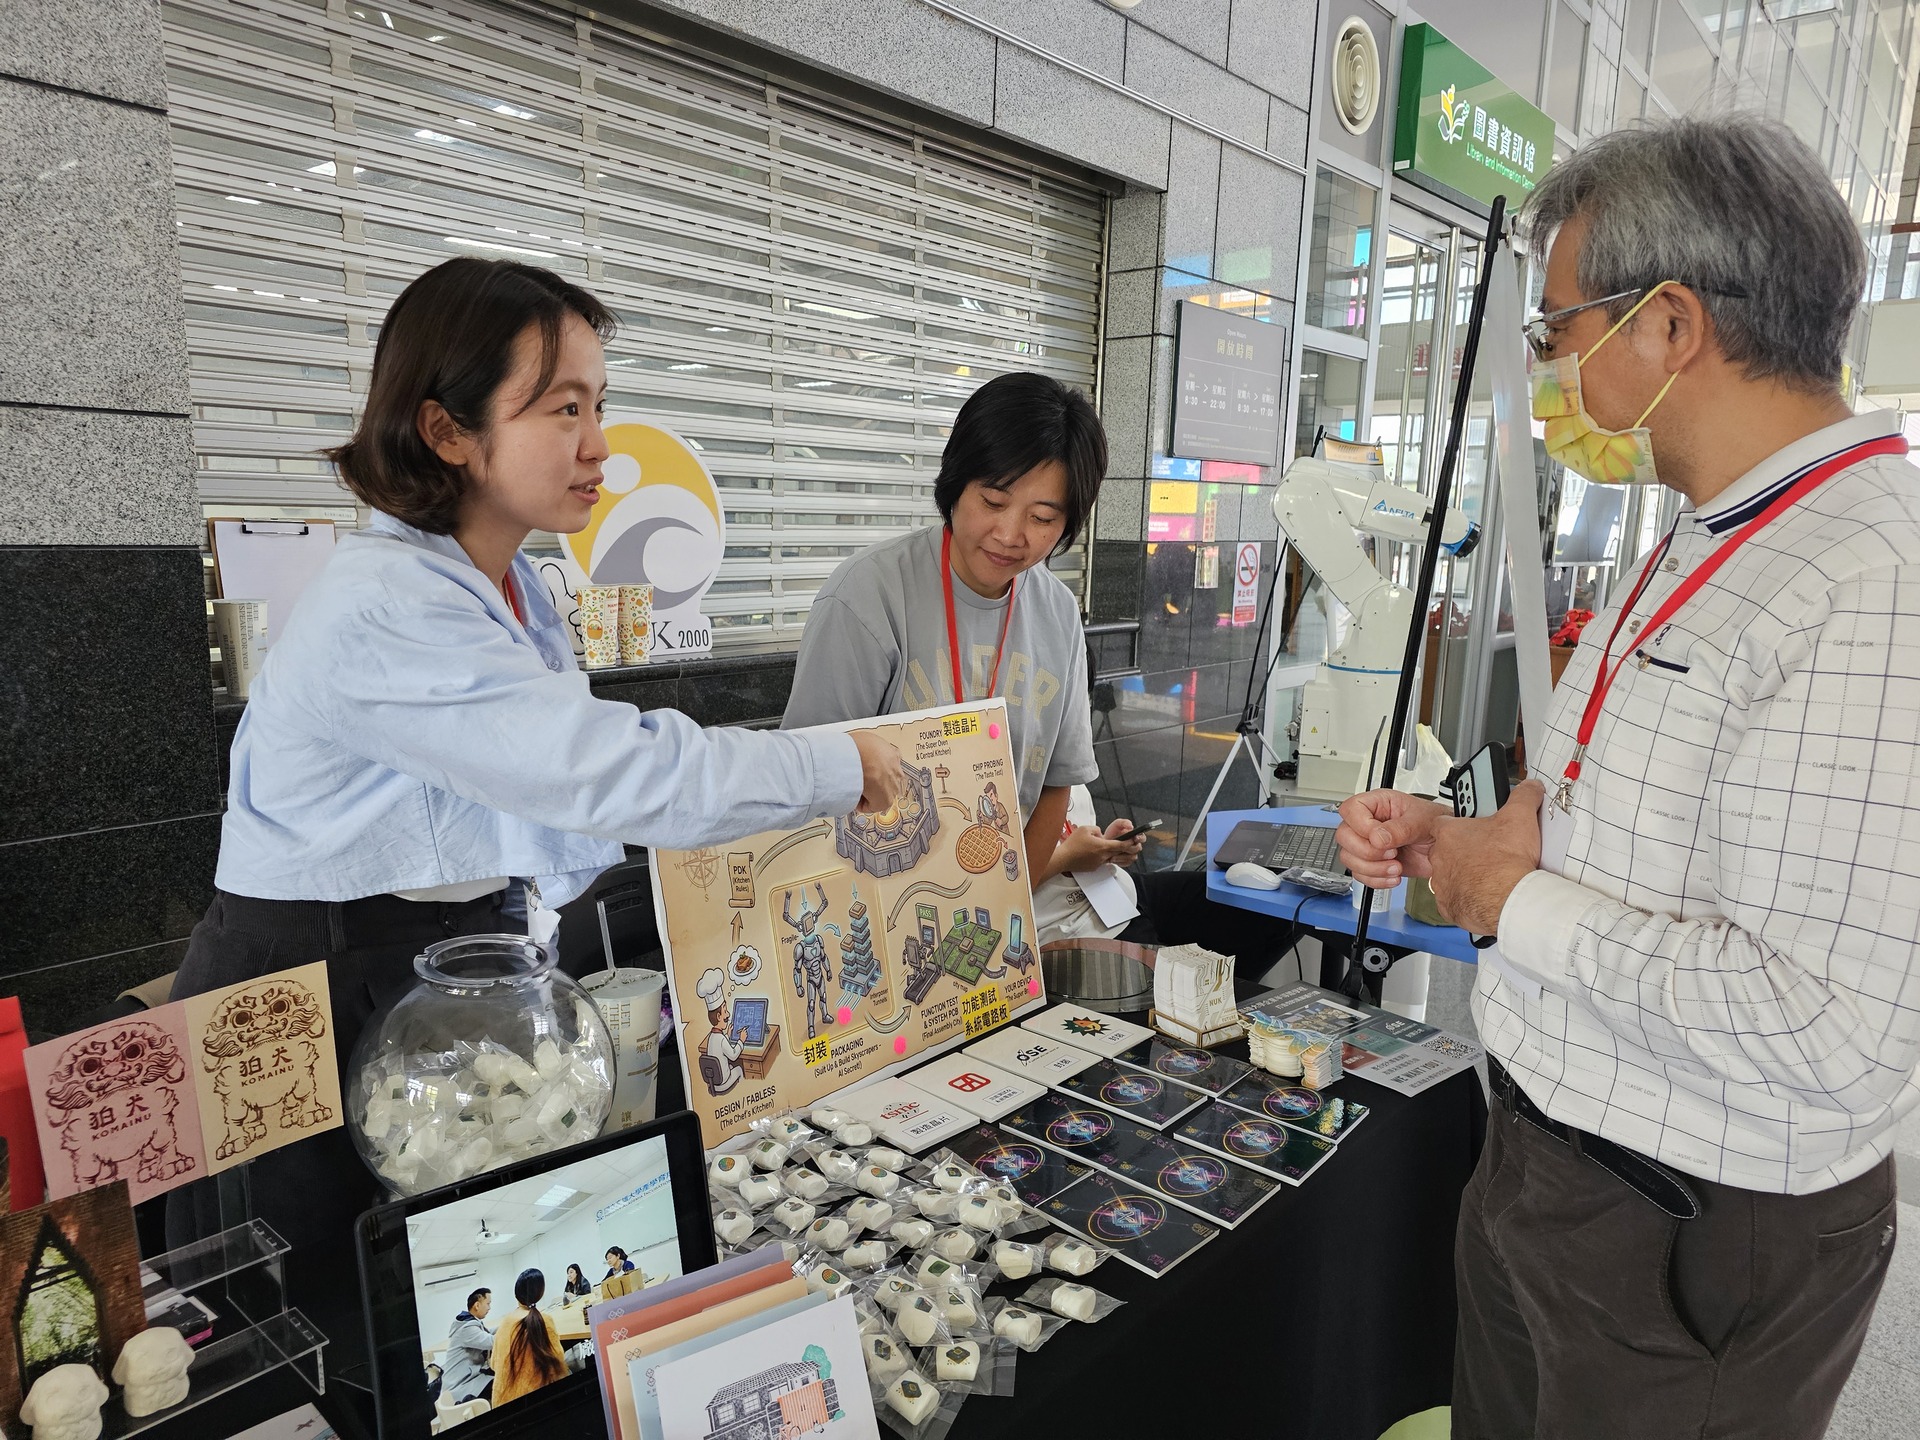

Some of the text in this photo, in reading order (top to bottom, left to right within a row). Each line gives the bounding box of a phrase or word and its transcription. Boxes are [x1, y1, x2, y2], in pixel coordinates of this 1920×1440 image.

[1473, 106, 1536, 173] 圖書資訊館
[1217, 338, 1253, 360] 開放時間
[1185, 395, 1198, 405] 8:30
[1210, 400, 1226, 410] 22:00
[1238, 404, 1249, 413] 8:30
[1261, 407, 1274, 417] 17:00
[678, 629, 709, 648] 2000
[1833, 639, 1874, 648] CLASSIC LOOK
[920, 729, 943, 740] FOUNDRY
[943, 717, 978, 736] 製造晶片
[920, 750, 934, 760] Central
[934, 748, 952, 758] Kitchen)
[926, 741, 938, 750] Super
[938, 740, 948, 748] Oven
[973, 759, 1004, 772] CHIP PROBING
[1812, 761, 1836, 770] CLASSIC
[1650, 808, 1686, 822] CLASSIC LOOK
[1731, 810, 1754, 819] CLASSIC
[733, 865, 747, 874] PDK
[732, 877, 750, 885] (Kitchen
[1791, 881, 1834, 894] CLASSIC LOOK
[920, 908, 932, 918] PASS
[1004, 982, 1017, 993] YOUR
[921, 996, 958, 1019] FUNCTION TEST
[961, 988, 997, 1015] 功能測試
[1209, 997, 1222, 1006] NUK
[610, 1004, 619, 1031] THE
[621, 1003, 631, 1027] LET
[923, 1008, 959, 1030] & SYSTEM PCB
[965, 1004, 1008, 1036] 系統電路板
[922, 1029, 933, 1041] (Final
[933, 1022, 953, 1037] Assembly
[804, 1040, 827, 1065] 封裝
[830, 1037, 864, 1059] PACKAGING
[239, 1046, 293, 1077] 狛犬
[814, 1065, 826, 1078] (Suit
[827, 1063, 834, 1073] Up
[839, 1056, 851, 1067] Build
[851, 1044, 879, 1062] Skyscrapers
[241, 1064, 294, 1087] KOMAINU
[1624, 1082, 1657, 1098] CLASSIC LOOK
[714, 1100, 740, 1120] DESIGN
[746, 1085, 776, 1106] FABLESS
[880, 1101, 920, 1120] tsmc
[88, 1094, 149, 1131] 狛犬
[720, 1098, 774, 1131] (The Chef's Kitchen)
[92, 1113, 152, 1141] KOMAINU
[910, 1116, 951, 1135] 製造晶片
